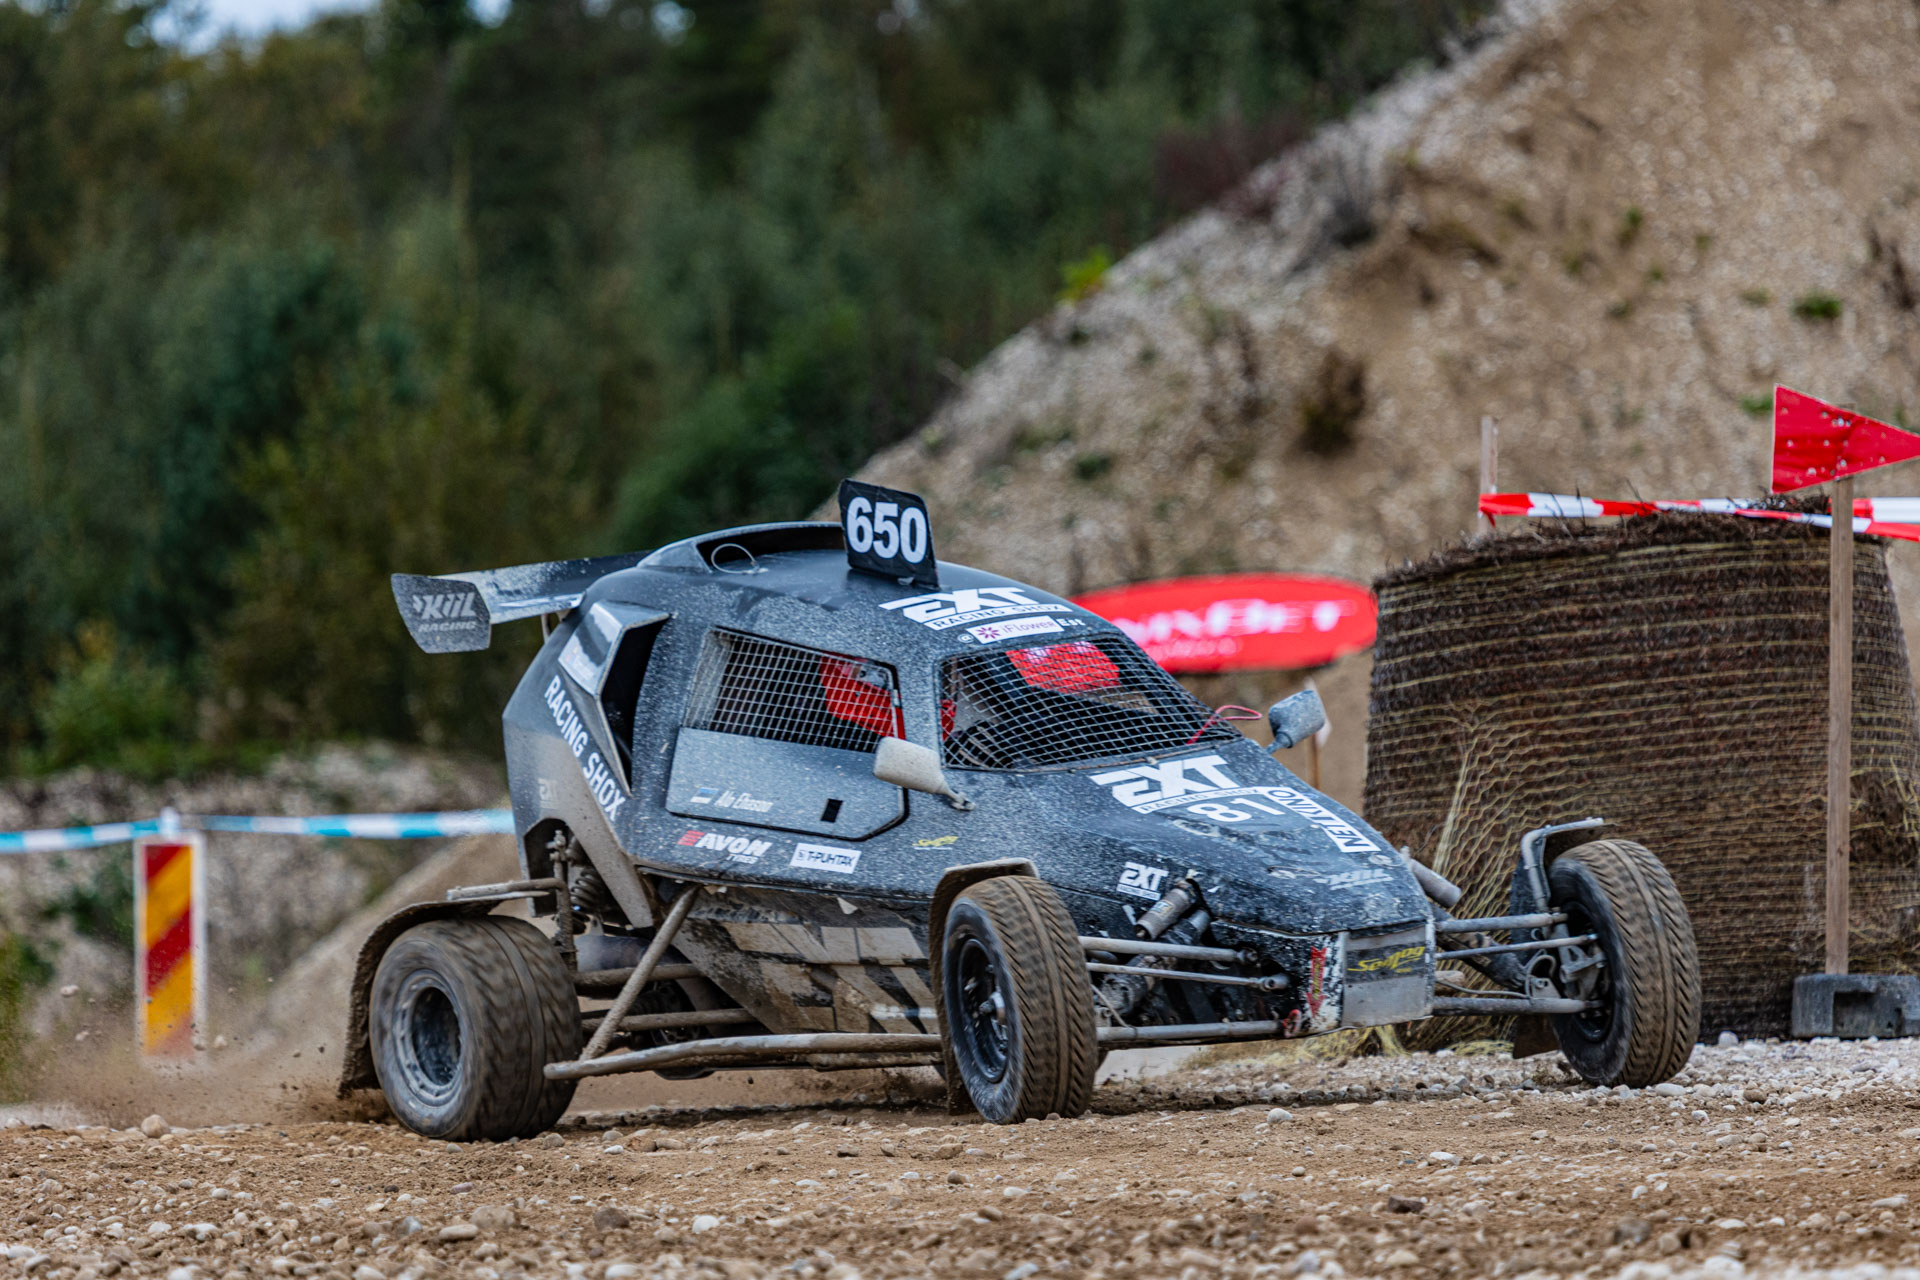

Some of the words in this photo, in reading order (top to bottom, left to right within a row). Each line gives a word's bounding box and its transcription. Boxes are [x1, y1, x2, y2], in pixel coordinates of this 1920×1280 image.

[847, 496, 928, 564] 650
[418, 621, 477, 633] RACING
[933, 609, 1005, 628] RACING
[1012, 603, 1065, 615] SHOX
[544, 674, 588, 758] RACING
[583, 752, 626, 821] SHOX
[1141, 793, 1210, 812] RACING
[1187, 797, 1286, 822] 81
[695, 833, 773, 857] AVON
[726, 854, 760, 865] TYRES
